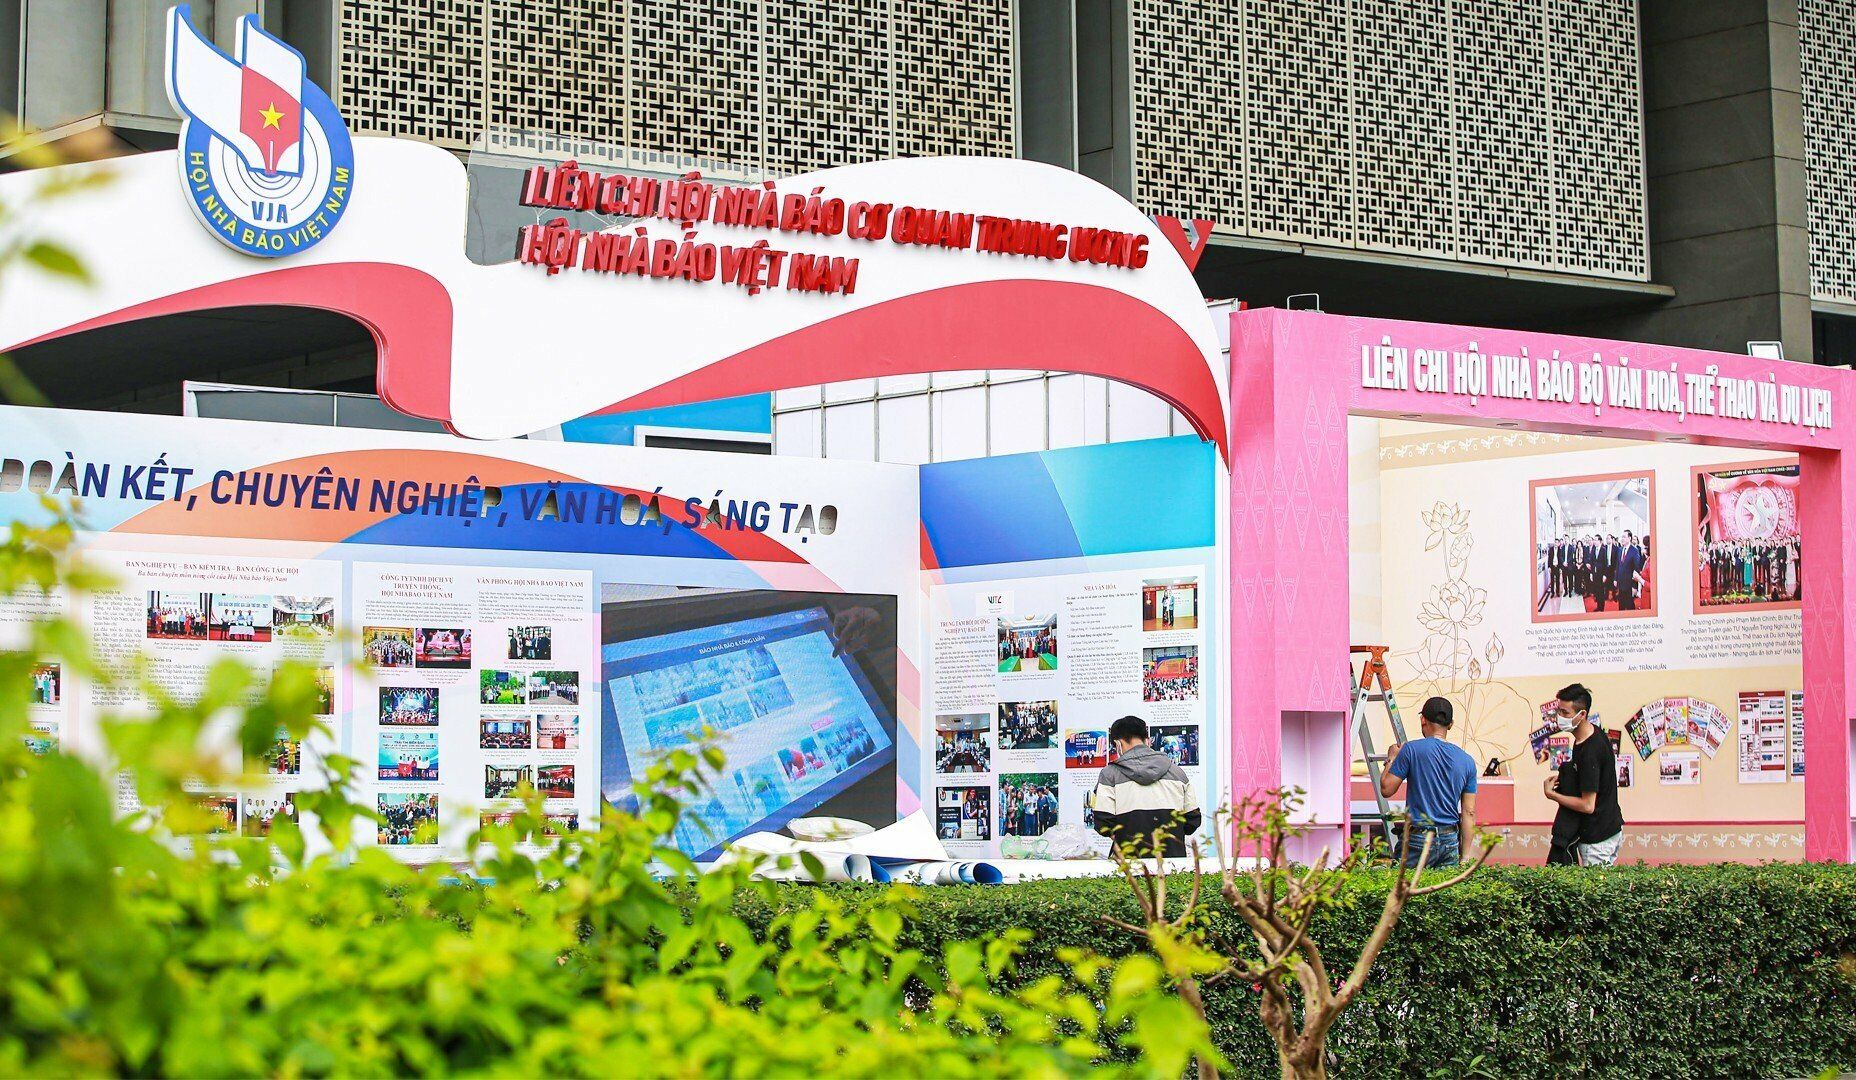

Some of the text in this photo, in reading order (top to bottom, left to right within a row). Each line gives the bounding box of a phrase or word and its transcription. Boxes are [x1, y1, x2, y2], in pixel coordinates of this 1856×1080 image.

[190, 152, 350, 250] HỘI NHÀ BÁO VIỆT NAM
[252, 200, 288, 224] VJA
[519, 160, 1150, 270] LIÊN CHI HỘI NHÀ BÁO CƠ QUAN TRUNG ƯƠNG
[514, 217, 859, 296] HỘI NHÀ BÁO VIỆT NAM
[1361, 335, 1832, 437] LIÊN CHI HỘI NHÀ BÁO BỘ VĂN HOÁ, THỂ THAO VÀ DU LỊCH
[120, 453, 198, 511] KẾT,
[210, 466, 360, 512] CHUYÊN
[369, 475, 508, 528] NGHIỆP,
[521, 480, 587, 523] VĂN
[595, 486, 673, 535] HOÁ,
[682, 489, 770, 532] SÁNG
[780, 502, 838, 543] TẠO
